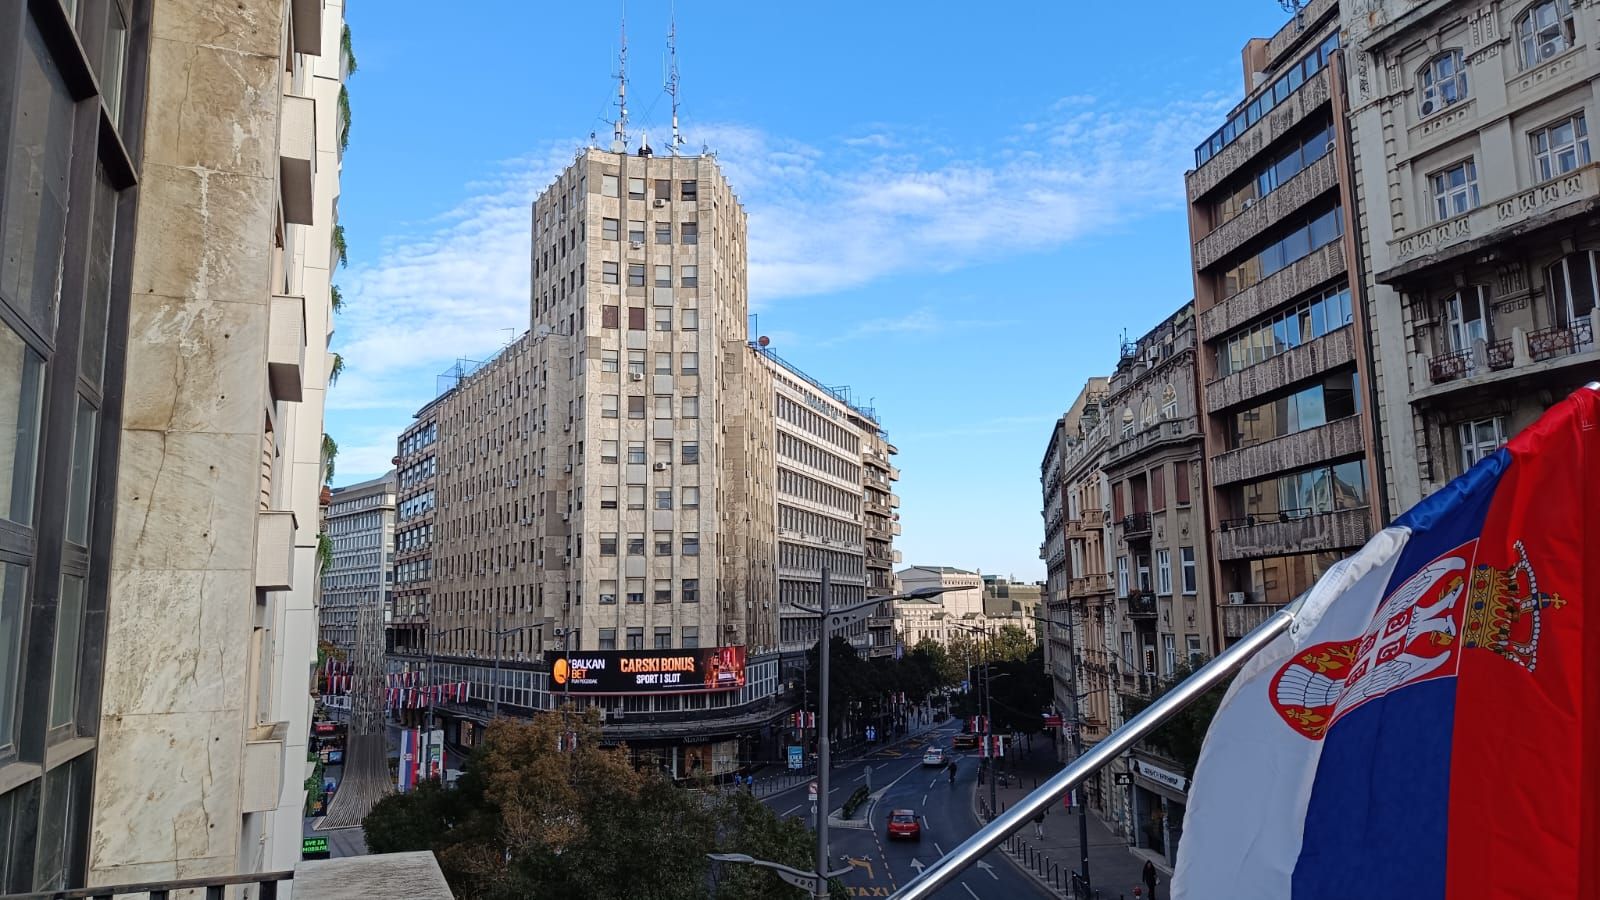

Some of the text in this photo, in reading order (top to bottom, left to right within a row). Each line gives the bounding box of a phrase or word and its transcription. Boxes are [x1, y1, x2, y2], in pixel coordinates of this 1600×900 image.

[571, 659, 605, 669] BALKAN
[620, 657, 695, 672] CARSKI BONUS
[571, 669, 588, 678] BET
[636, 673, 681, 684] SPORT I SLOT
[847, 887, 890, 896] TAXI
